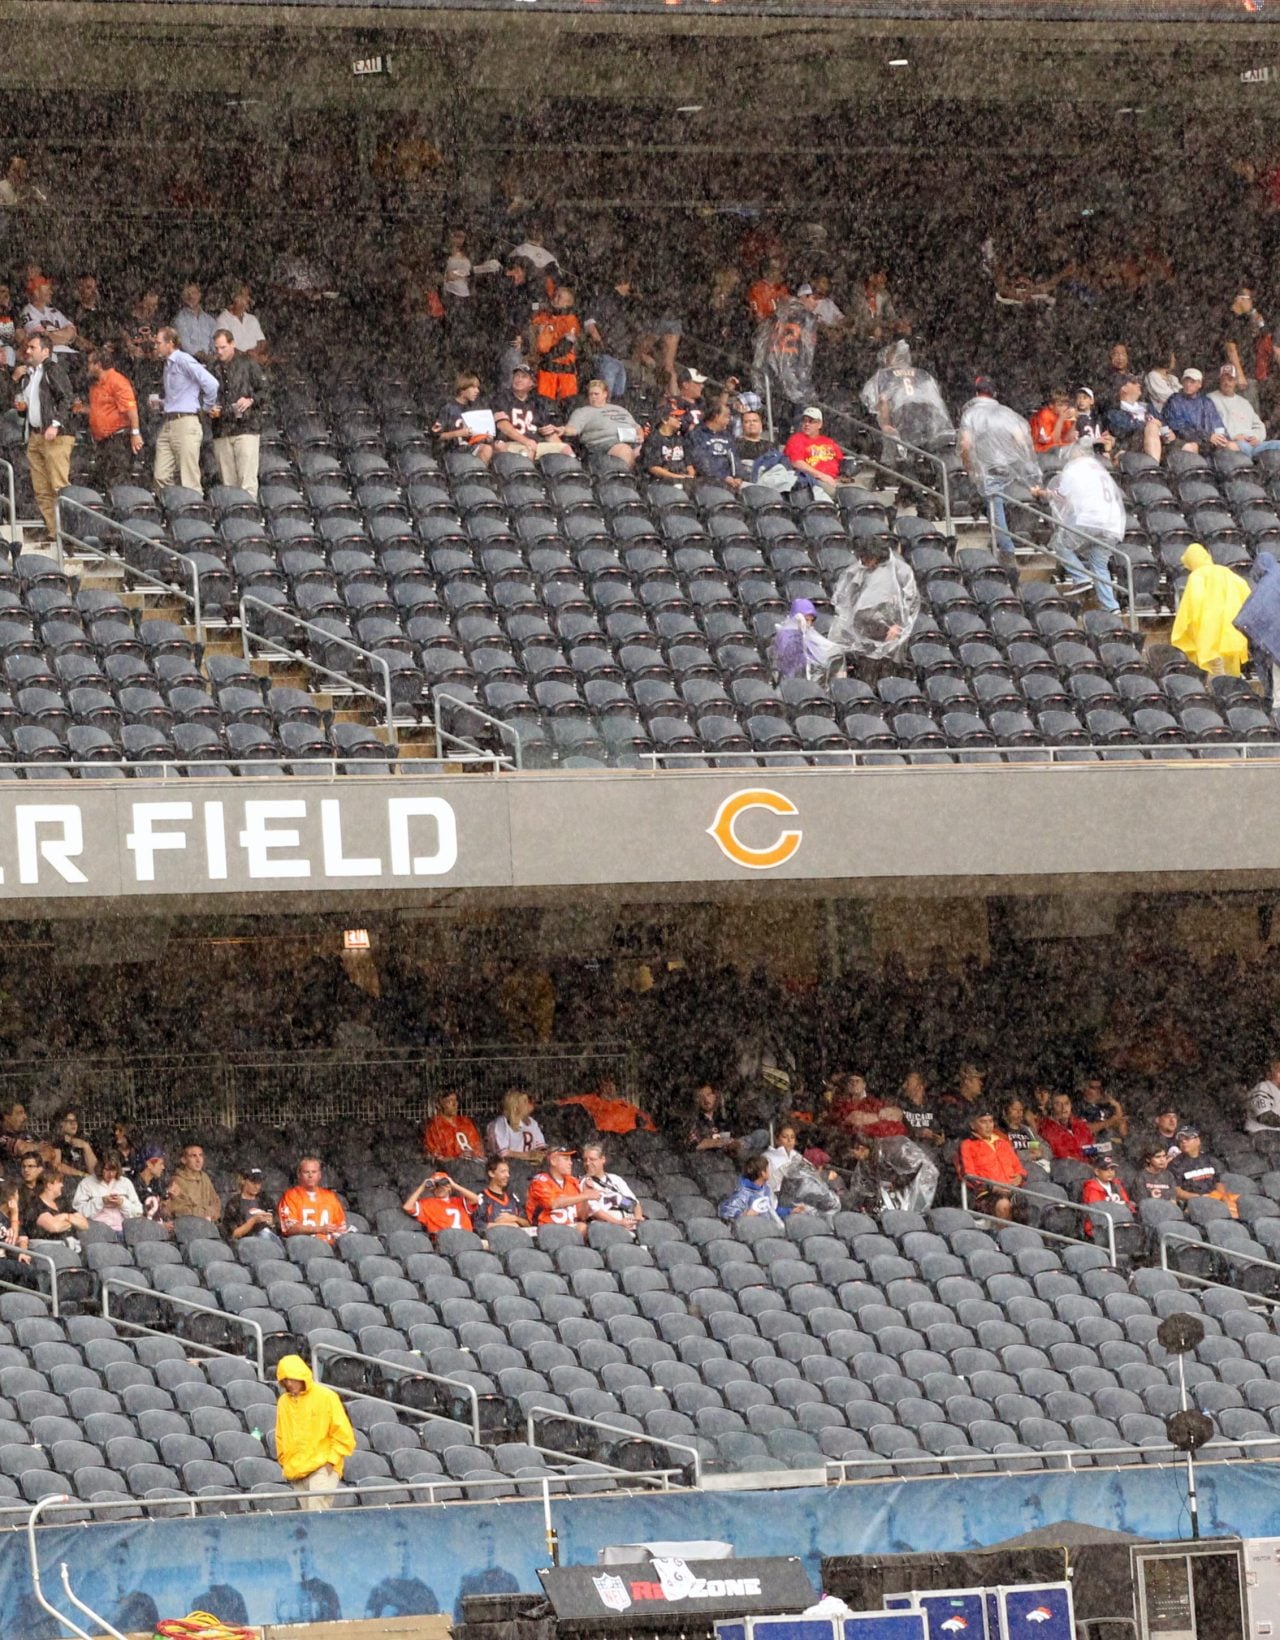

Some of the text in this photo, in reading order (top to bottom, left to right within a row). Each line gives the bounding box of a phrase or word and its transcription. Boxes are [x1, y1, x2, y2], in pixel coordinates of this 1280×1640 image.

[355, 57, 378, 72] EXIT
[903, 378, 914, 396] 6
[511, 408, 537, 435] 54
[705, 787, 803, 869] C
[126, 797, 458, 881] FIELD
[455, 1131, 472, 1151] 8
[445, 1208, 462, 1229] 7
[630, 1578, 762, 1600] RE ZONE
